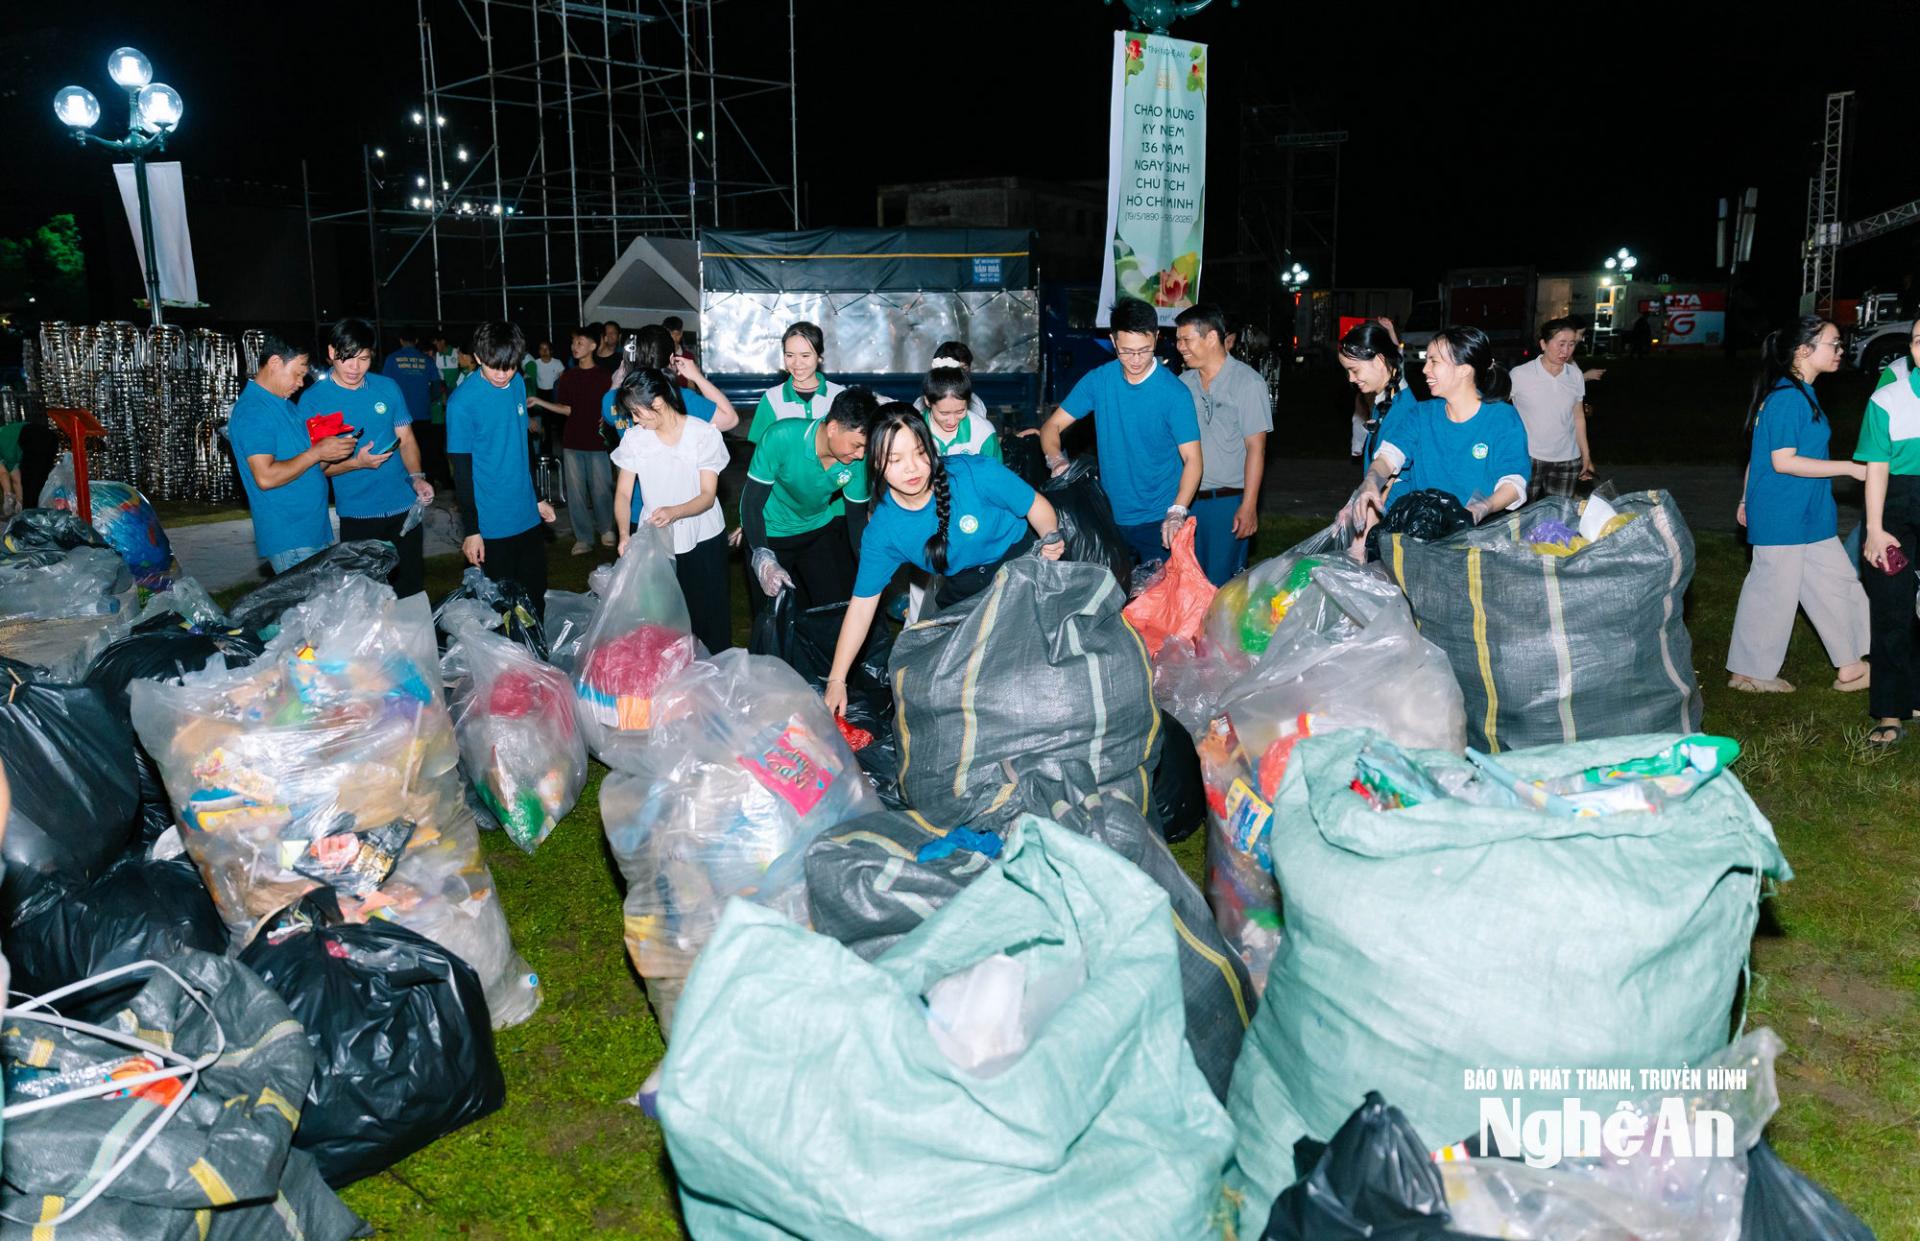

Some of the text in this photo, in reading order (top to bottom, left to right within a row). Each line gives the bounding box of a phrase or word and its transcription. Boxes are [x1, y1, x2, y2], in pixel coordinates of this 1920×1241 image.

[1141, 142, 1158, 153] 136
[1165, 161, 1190, 174] SINH
[1166, 197, 1194, 209] MINH
